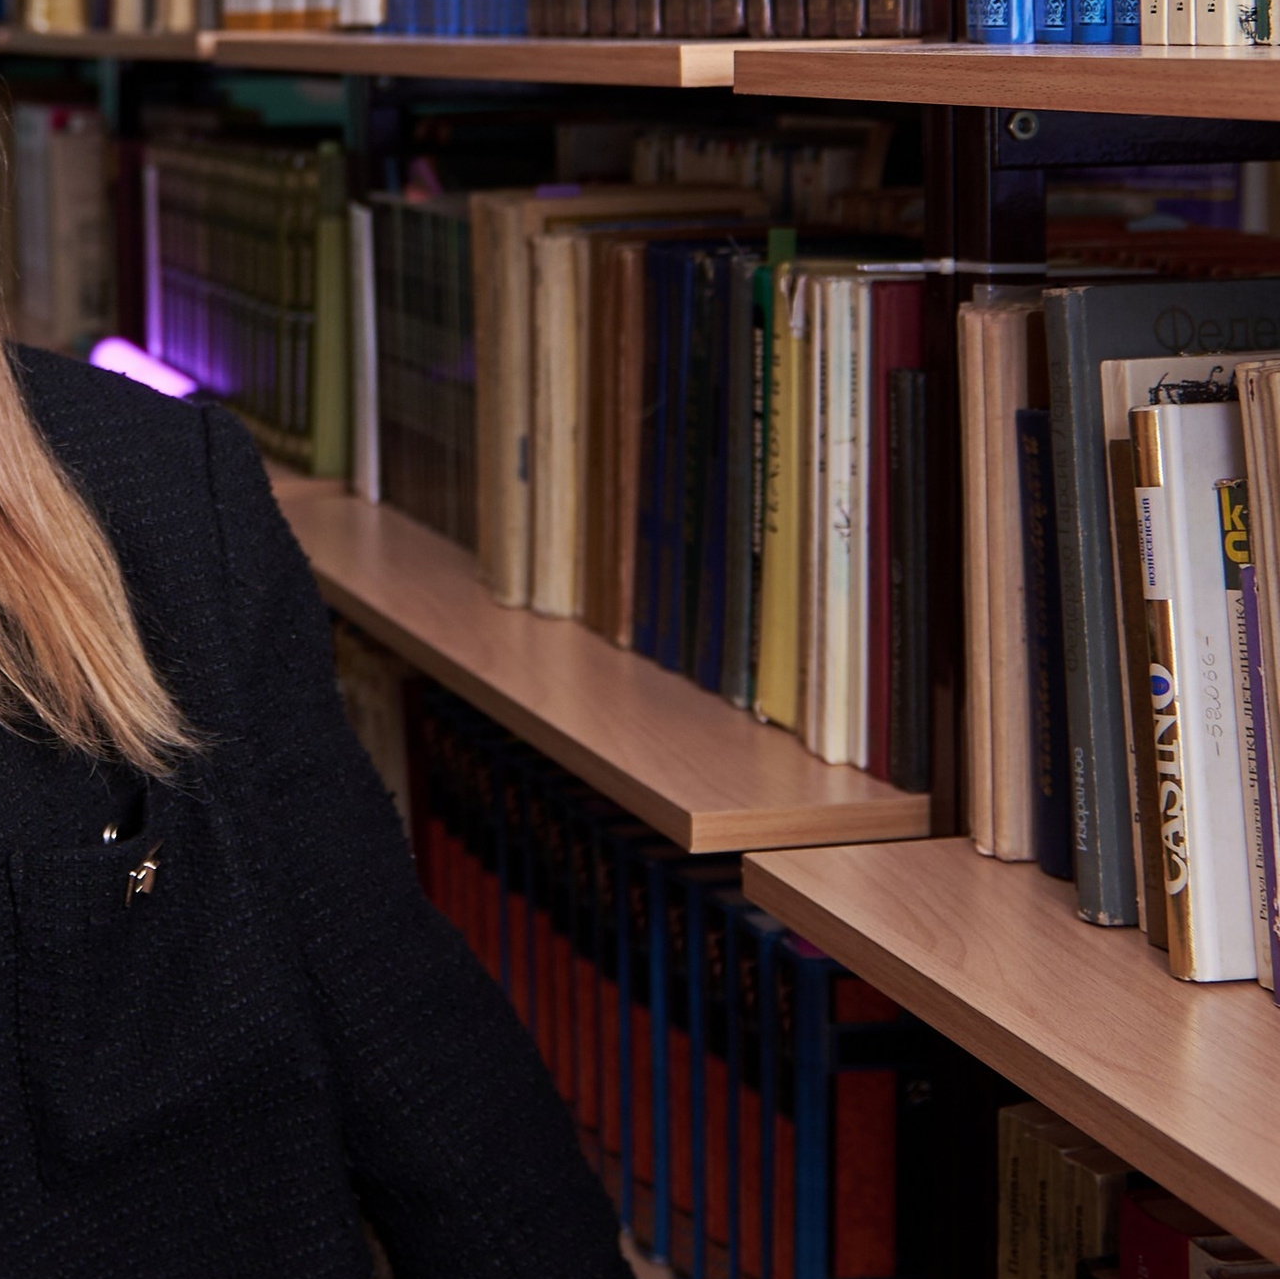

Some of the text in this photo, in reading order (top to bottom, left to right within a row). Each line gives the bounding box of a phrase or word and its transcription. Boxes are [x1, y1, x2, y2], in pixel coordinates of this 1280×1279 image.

[1142, 497, 1156, 587] ВОЗНЕСЕНСКИЙ
[1074, 746, 1090, 852] Избранное
[1244, 726, 1259, 788] ЧЕТКИ
